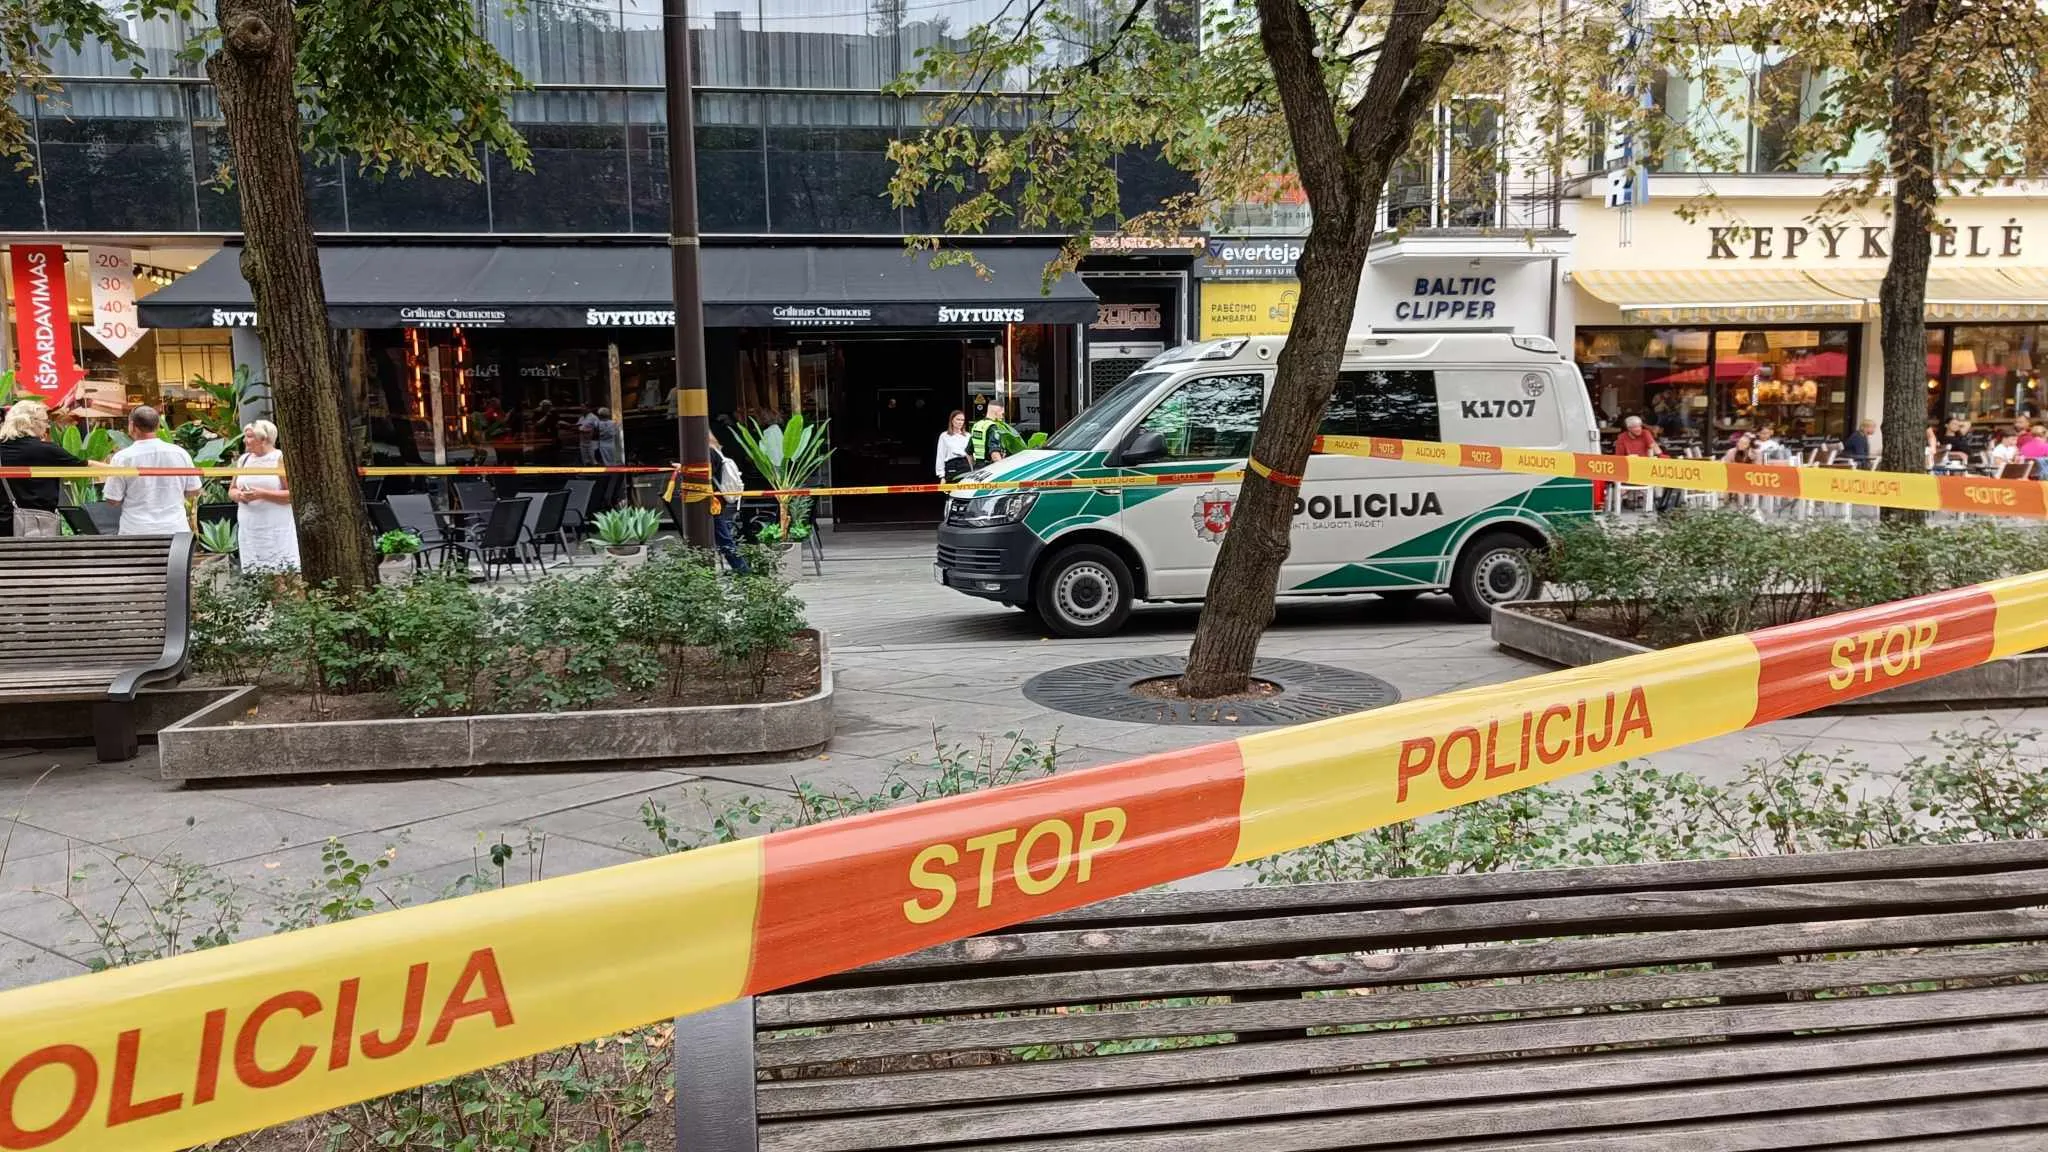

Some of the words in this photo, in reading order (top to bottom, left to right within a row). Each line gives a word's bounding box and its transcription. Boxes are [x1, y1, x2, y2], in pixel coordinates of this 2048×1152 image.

[1707, 217, 2023, 259] KEPYKĖLĖ
[1222, 243, 1304, 264] everteja
[1265, 268, 1295, 276] BIUR
[1414, 277, 1496, 296] BALTIC
[212, 308, 257, 326] ŠVYT
[938, 306, 1025, 322] ŠVYTURYS
[1396, 300, 1496, 320] CLIPPER
[28, 252, 58, 389] IŠPARDAVIMAS
[1461, 399, 1536, 419] K1707
[0, 947, 514, 1150] OLICIJA
[902, 806, 1127, 925] STOP
[1396, 685, 1653, 803] POLICIJA
[1828, 619, 1938, 690] STOP
